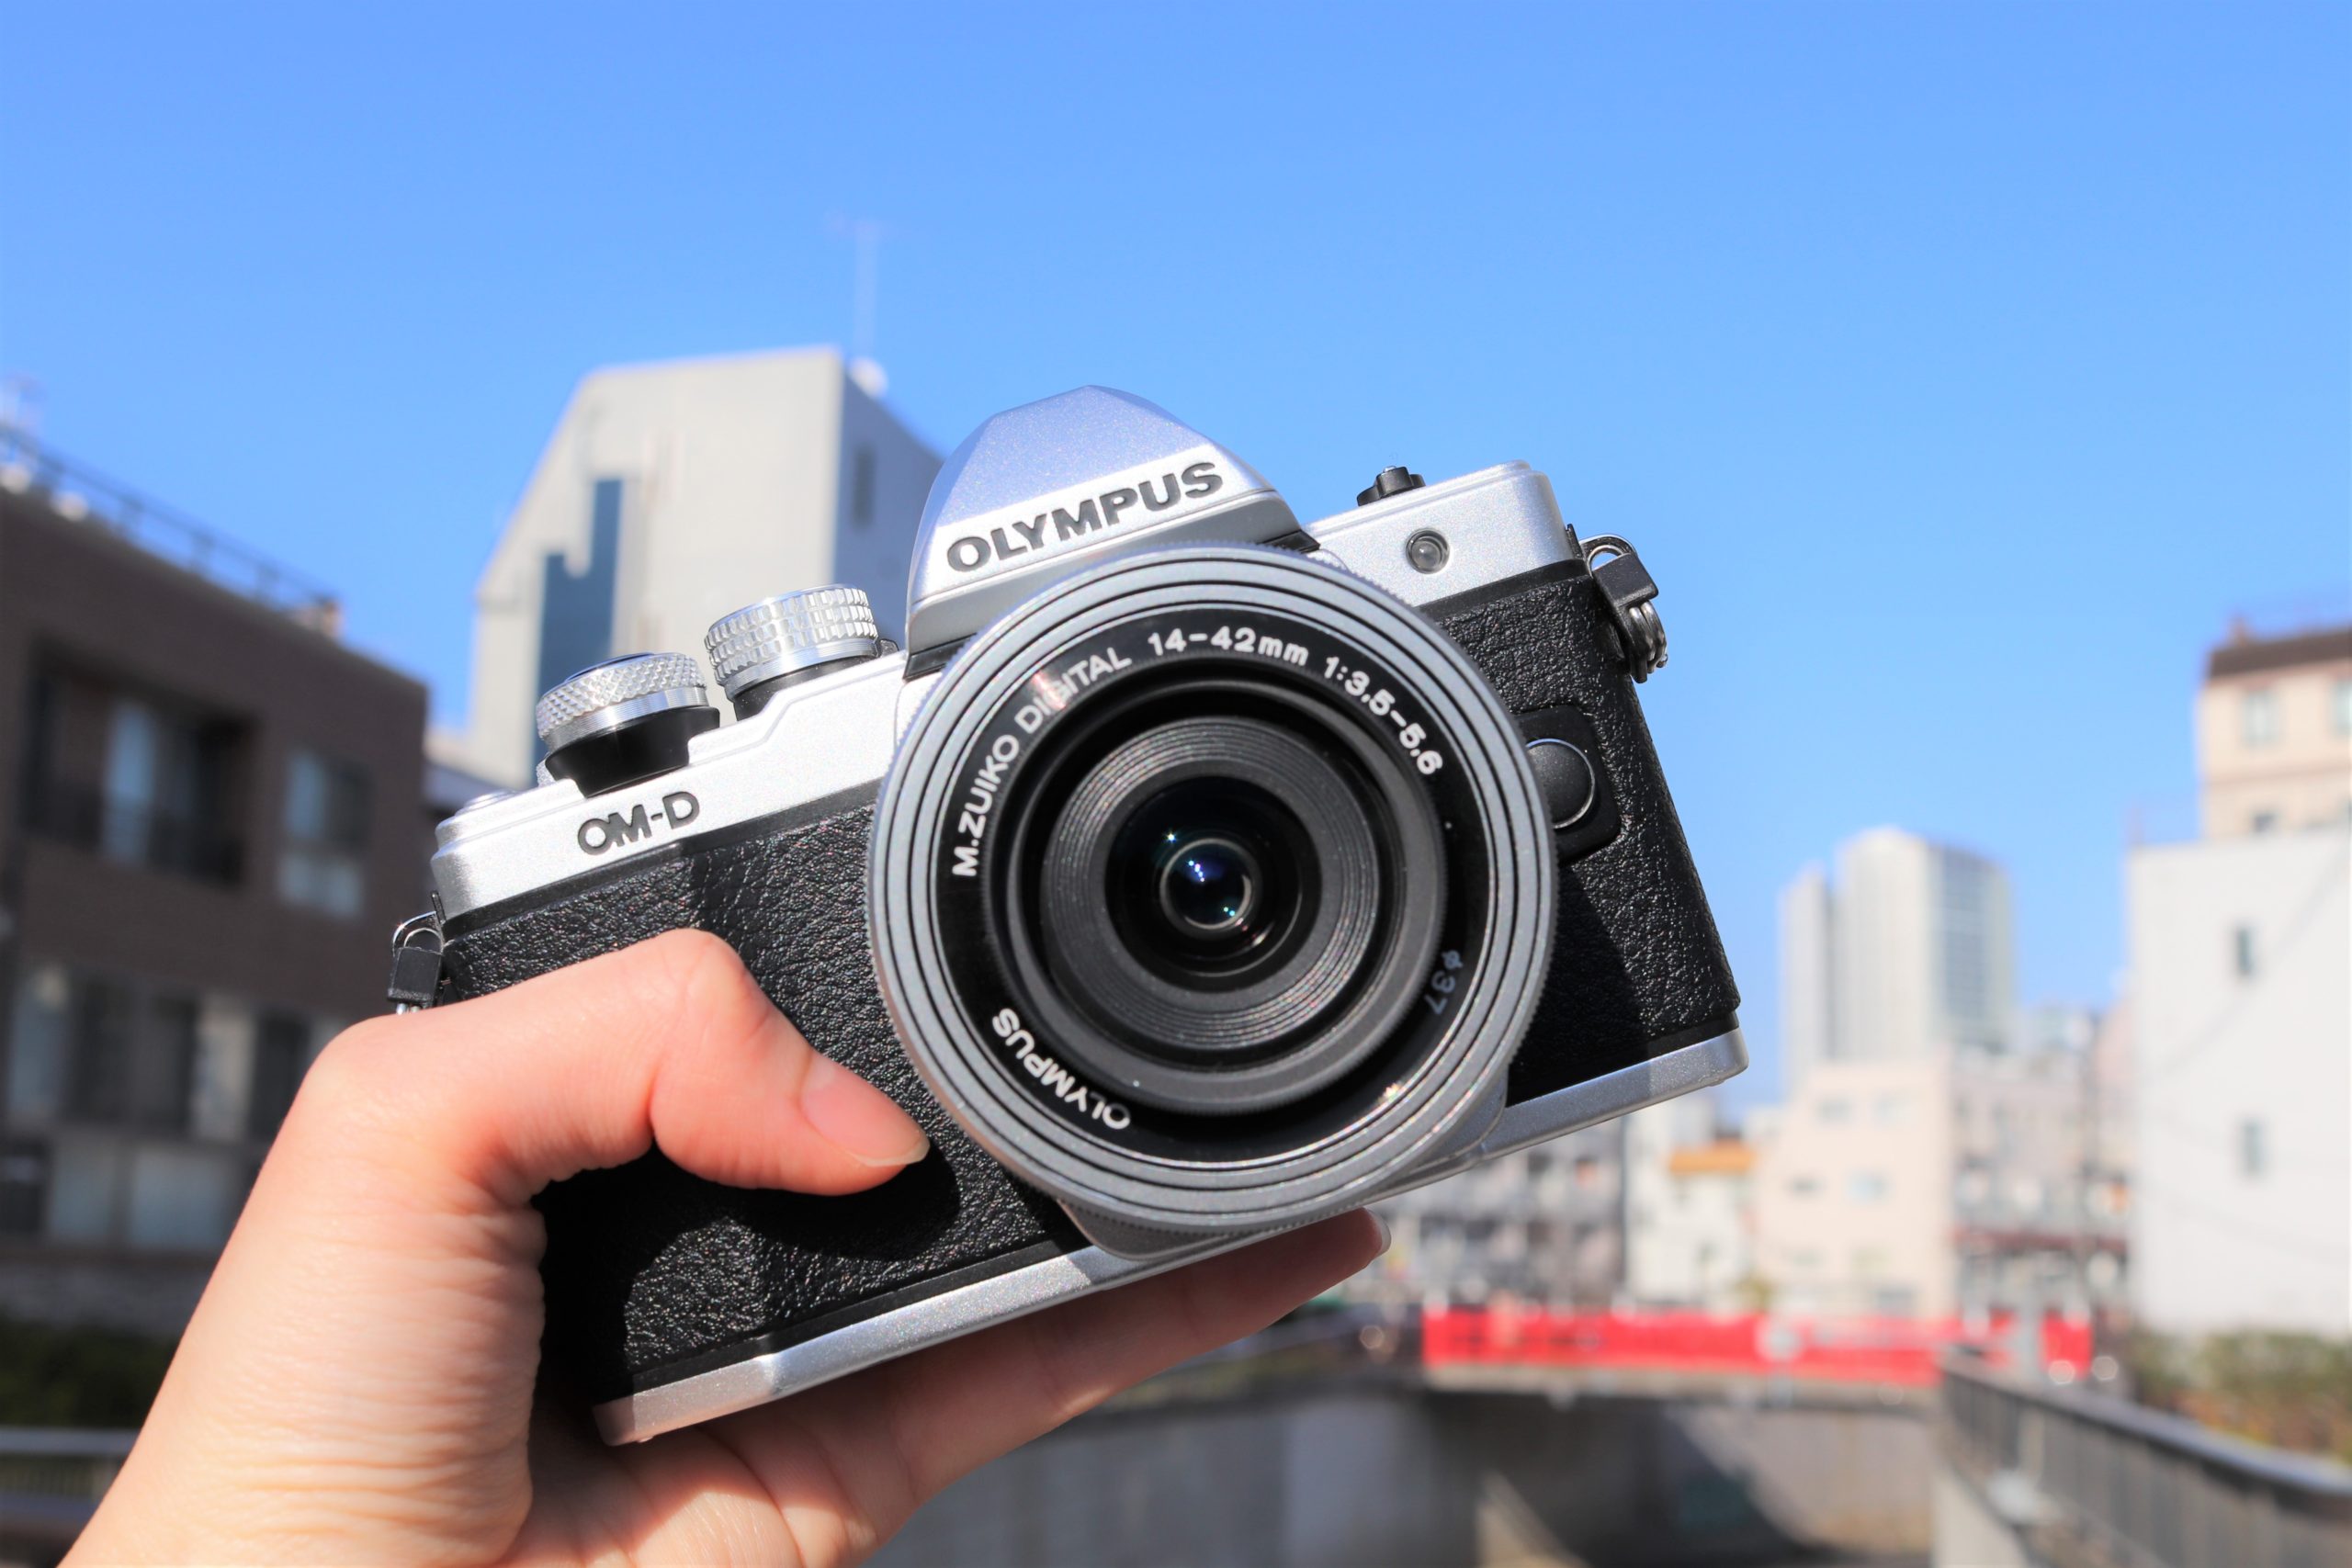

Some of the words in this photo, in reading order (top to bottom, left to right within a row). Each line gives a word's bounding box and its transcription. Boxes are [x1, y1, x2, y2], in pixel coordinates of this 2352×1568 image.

[947, 462, 1223, 572] OLYMPUS
[952, 734, 1019, 876] M.ZUIKO
[1014, 647, 1132, 734] DIGITAL
[1148, 626, 1309, 666] 14-42mm
[1324, 656, 1443, 774] 1:3.5-5.6
[578, 791, 700, 855] OM-D
[991, 1008, 1131, 1130] OLYMPUS
